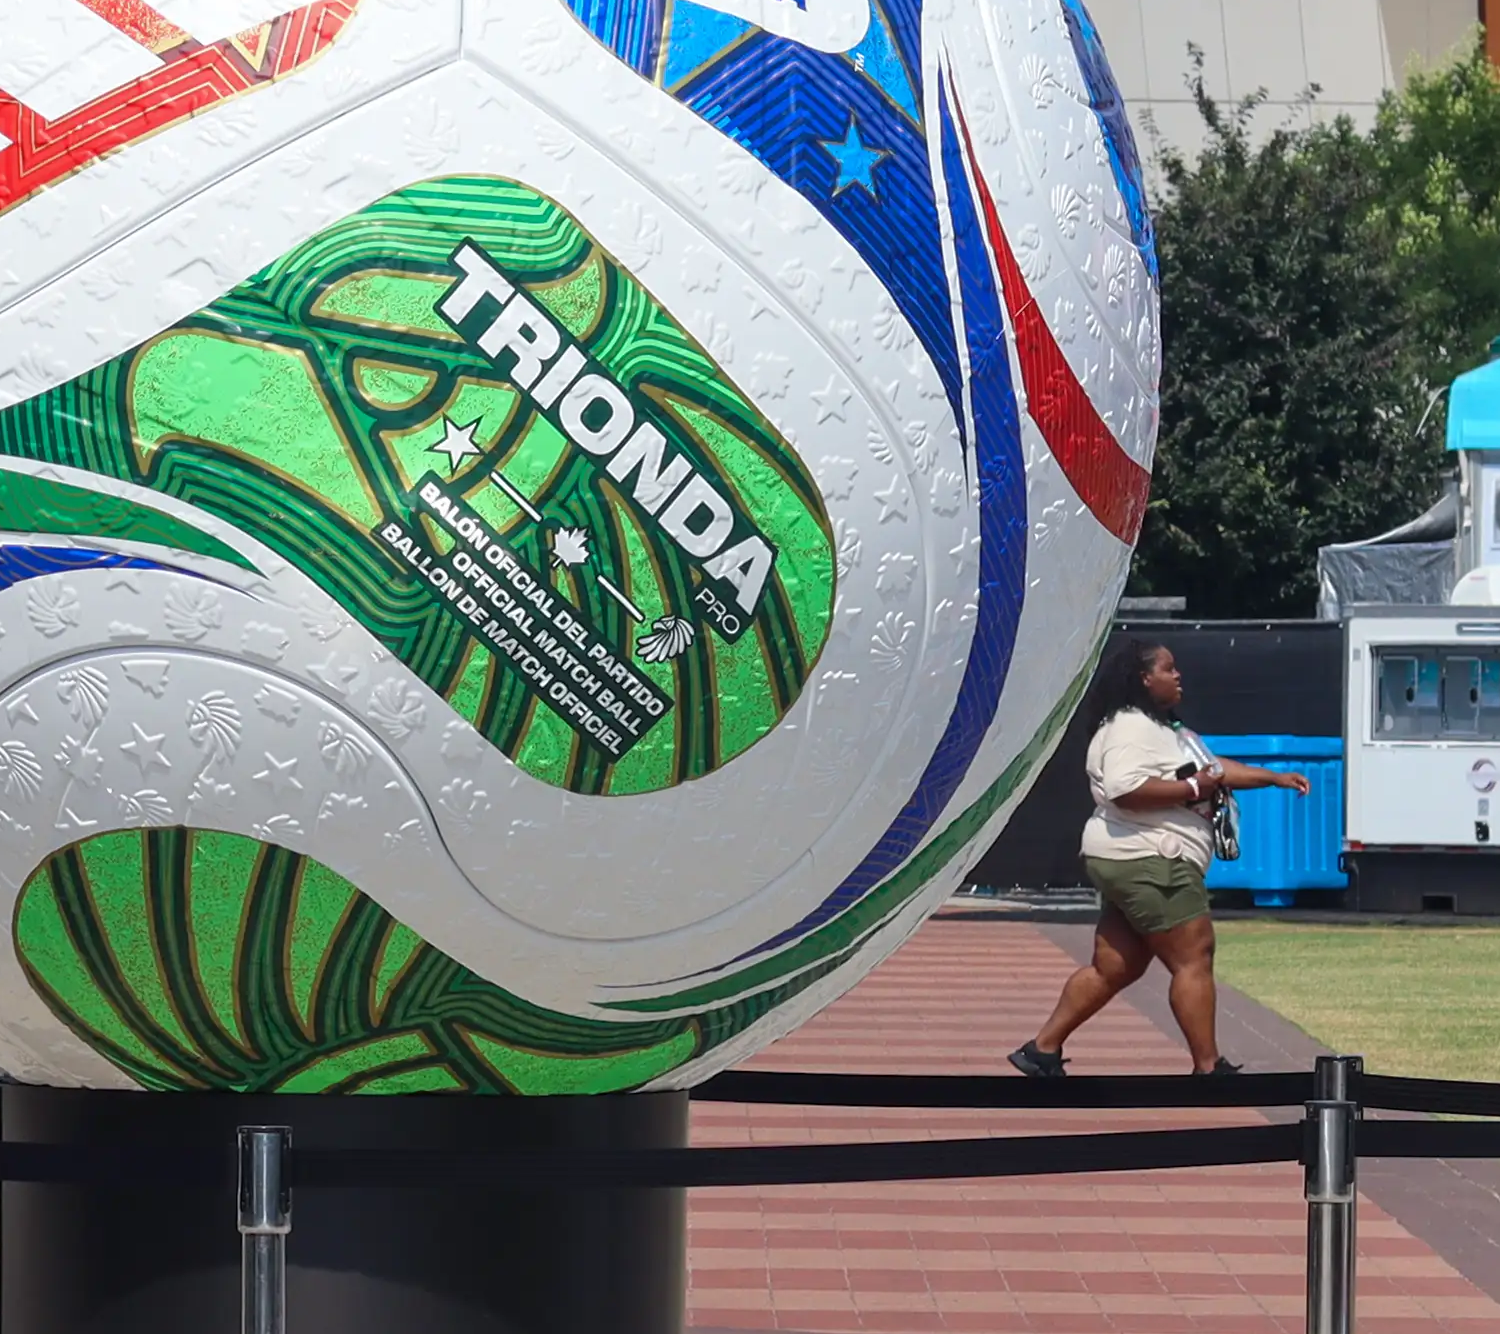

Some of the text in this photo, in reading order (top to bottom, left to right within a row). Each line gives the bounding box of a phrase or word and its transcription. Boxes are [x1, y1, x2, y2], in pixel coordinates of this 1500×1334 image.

[439, 243, 774, 616] TRIONDA
[380, 522, 626, 755] BALLON DE MATCH OFFICIEL
[418, 481, 665, 717] BALÓN OFICIAL DEL PARTIDO
[452, 551, 643, 737] OFFICIAL MATCH BALL
[694, 587, 741, 636] PRO
